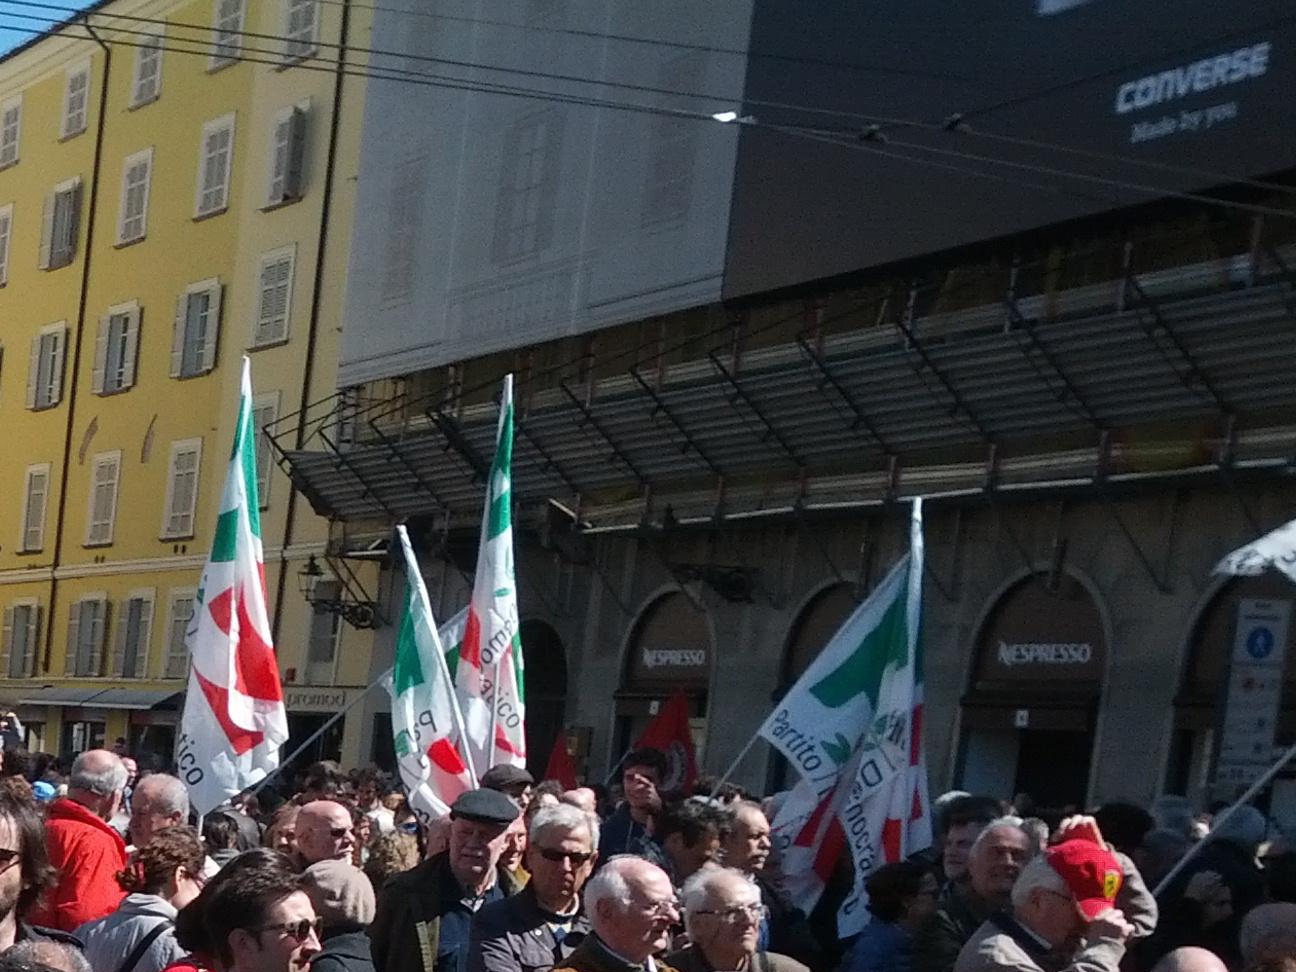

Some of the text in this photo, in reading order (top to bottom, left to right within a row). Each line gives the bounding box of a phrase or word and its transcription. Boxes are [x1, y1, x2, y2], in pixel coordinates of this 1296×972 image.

[1115, 41, 1272, 113] CONVERSE
[643, 648, 705, 669] NESPRESSO
[998, 640, 1091, 666] NESPRESSO
[287, 690, 346, 709] promod
[772, 708, 822, 772] Partito
